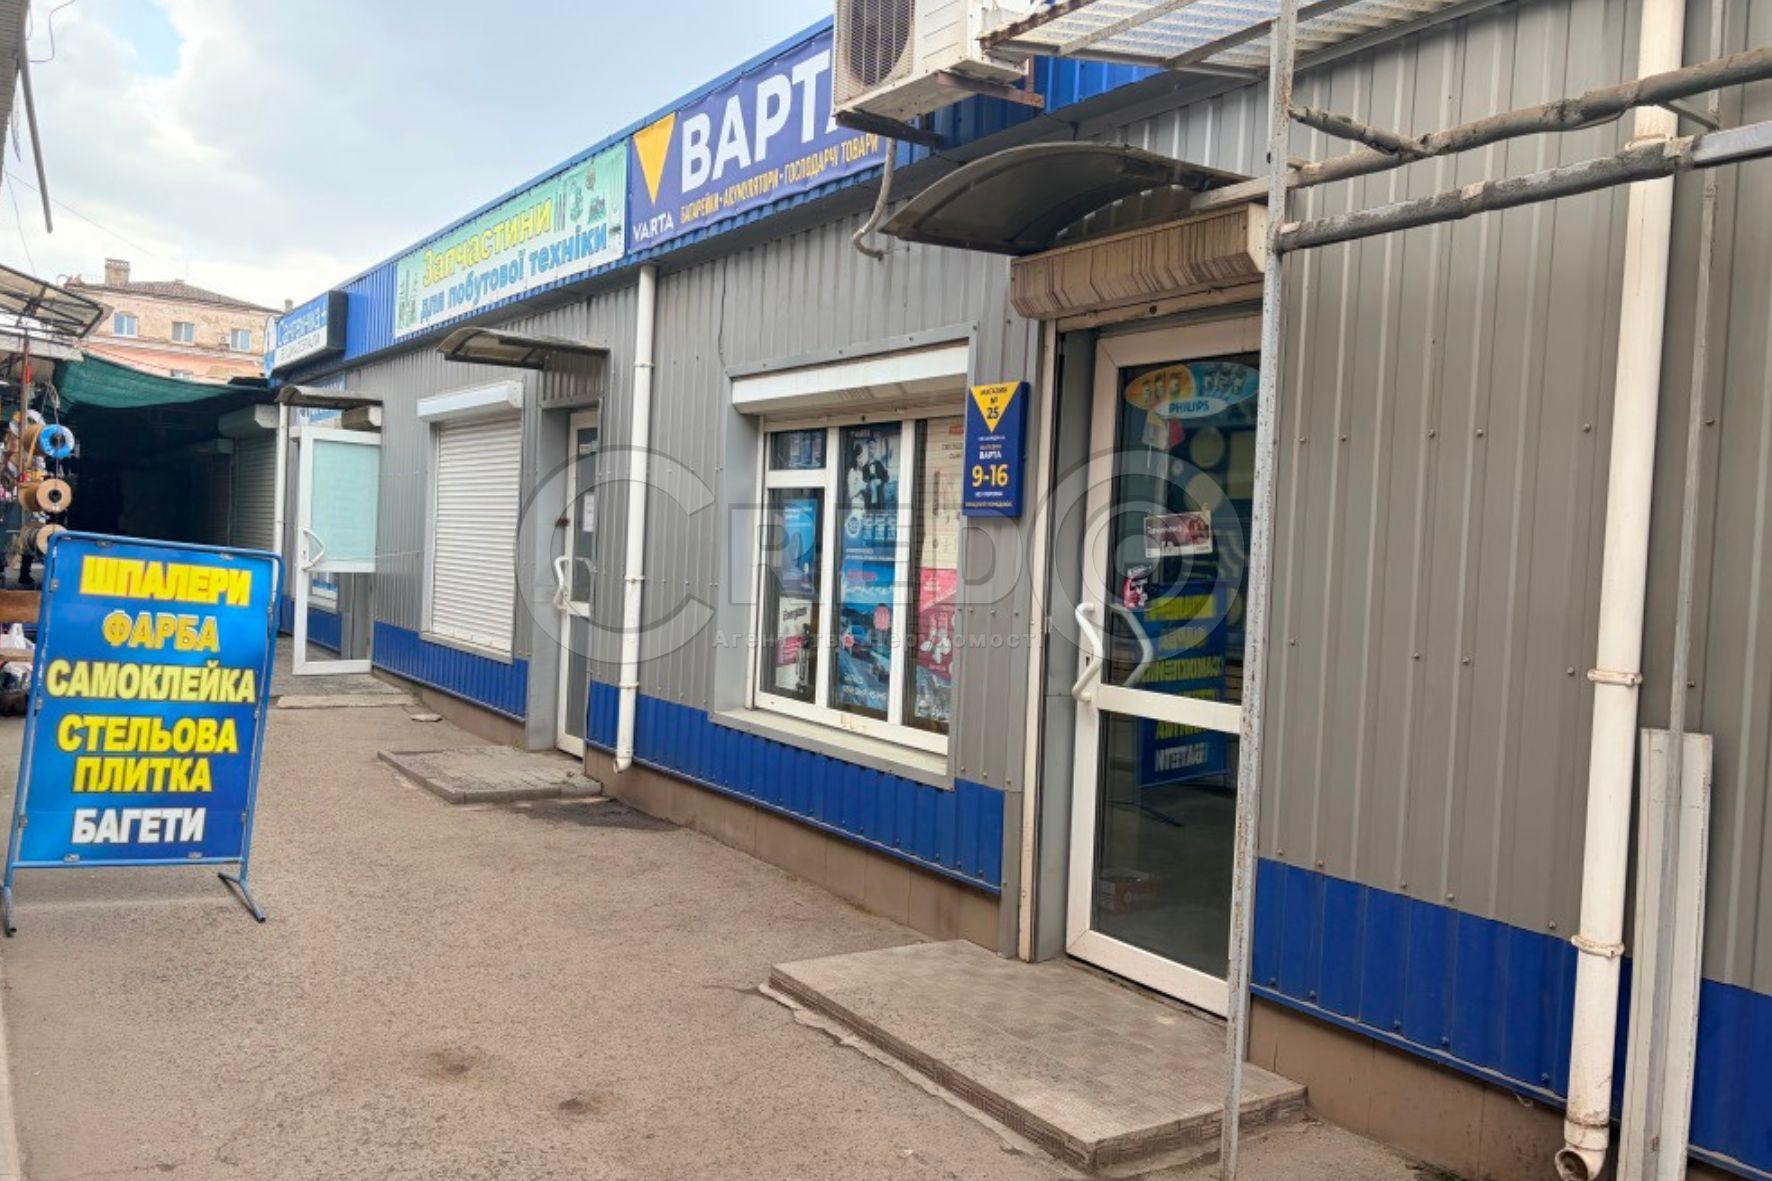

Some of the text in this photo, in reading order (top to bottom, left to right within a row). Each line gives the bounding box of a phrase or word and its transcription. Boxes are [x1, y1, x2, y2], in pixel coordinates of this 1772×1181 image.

[681, 48, 839, 193] ВАРТ
[422, 197, 552, 288] Запчастини
[633, 211, 675, 242] VARTA
[420, 223, 607, 324] для побутової техніки
[987, 406, 999, 419] 25
[1168, 401, 1210, 413] PHILIPS
[972, 464, 1008, 487] 9-16
[79, 556, 252, 606] ШПАЛЕРИ
[102, 610, 219, 652] ФАРБА
[46, 659, 257, 702] САМОКЛЕЙКА
[57, 714, 238, 753] СТЕЛЬОВА
[73, 758, 211, 792] ПЛИТКА
[71, 808, 206, 844] БАГЕТИ
